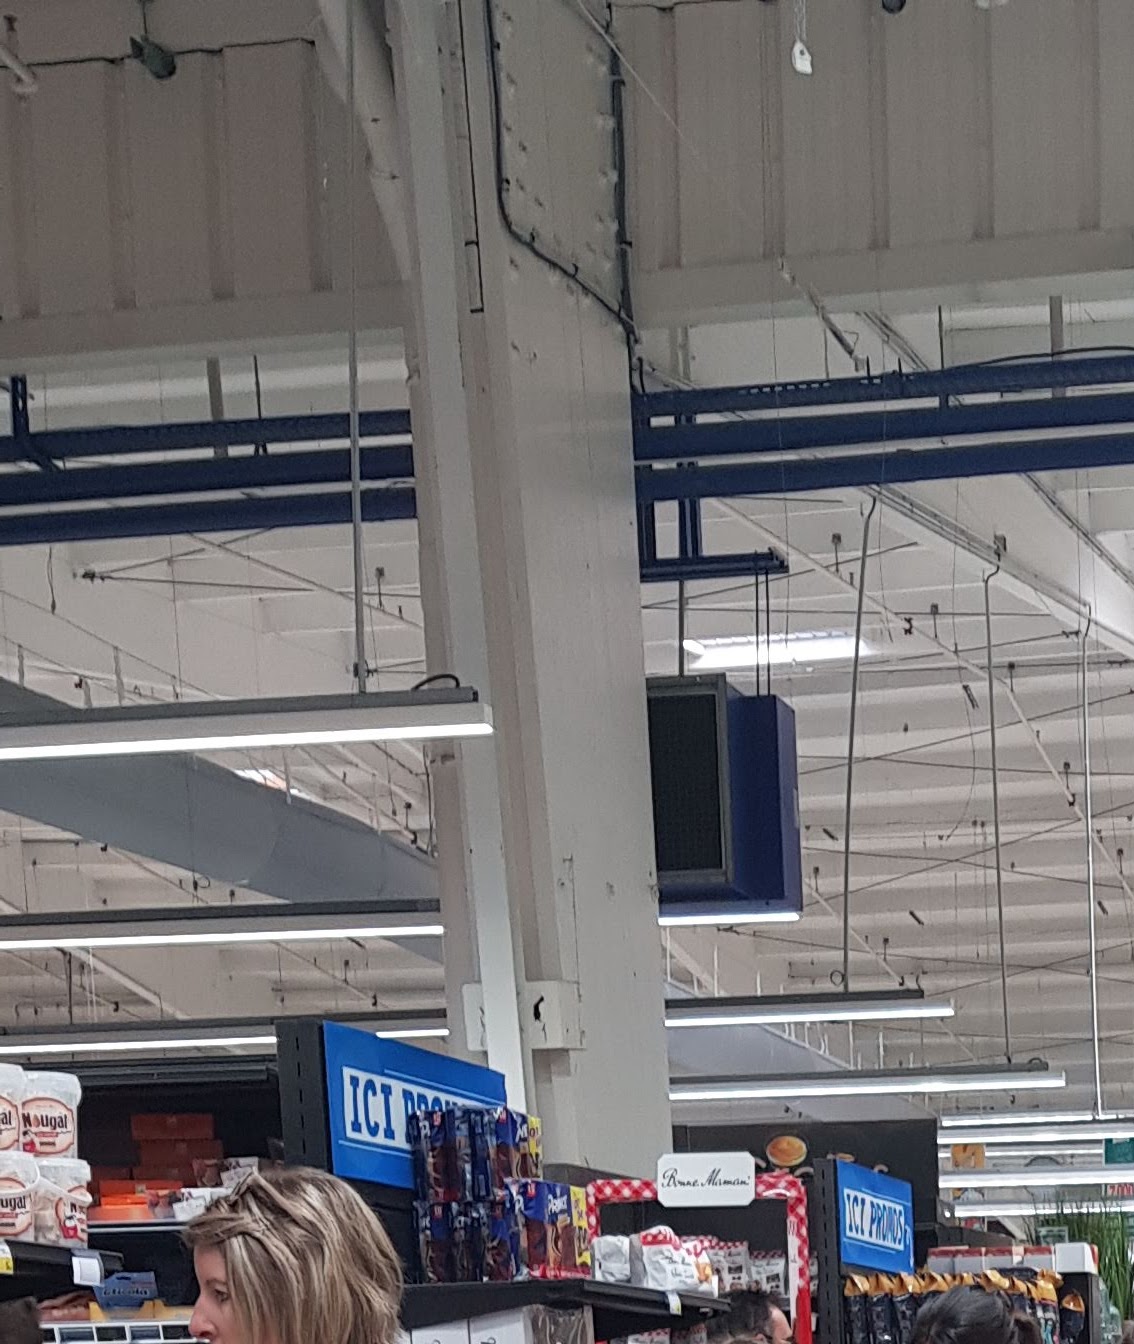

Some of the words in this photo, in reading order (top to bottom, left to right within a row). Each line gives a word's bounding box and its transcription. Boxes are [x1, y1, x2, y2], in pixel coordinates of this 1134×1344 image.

[350, 1075, 396, 1140] ICI
[661, 1167, 699, 1189] Bonne
[700, 1167, 750, 1188] Maman
[846, 1193, 866, 1234] ICI
[869, 1198, 905, 1247] PROMOS
